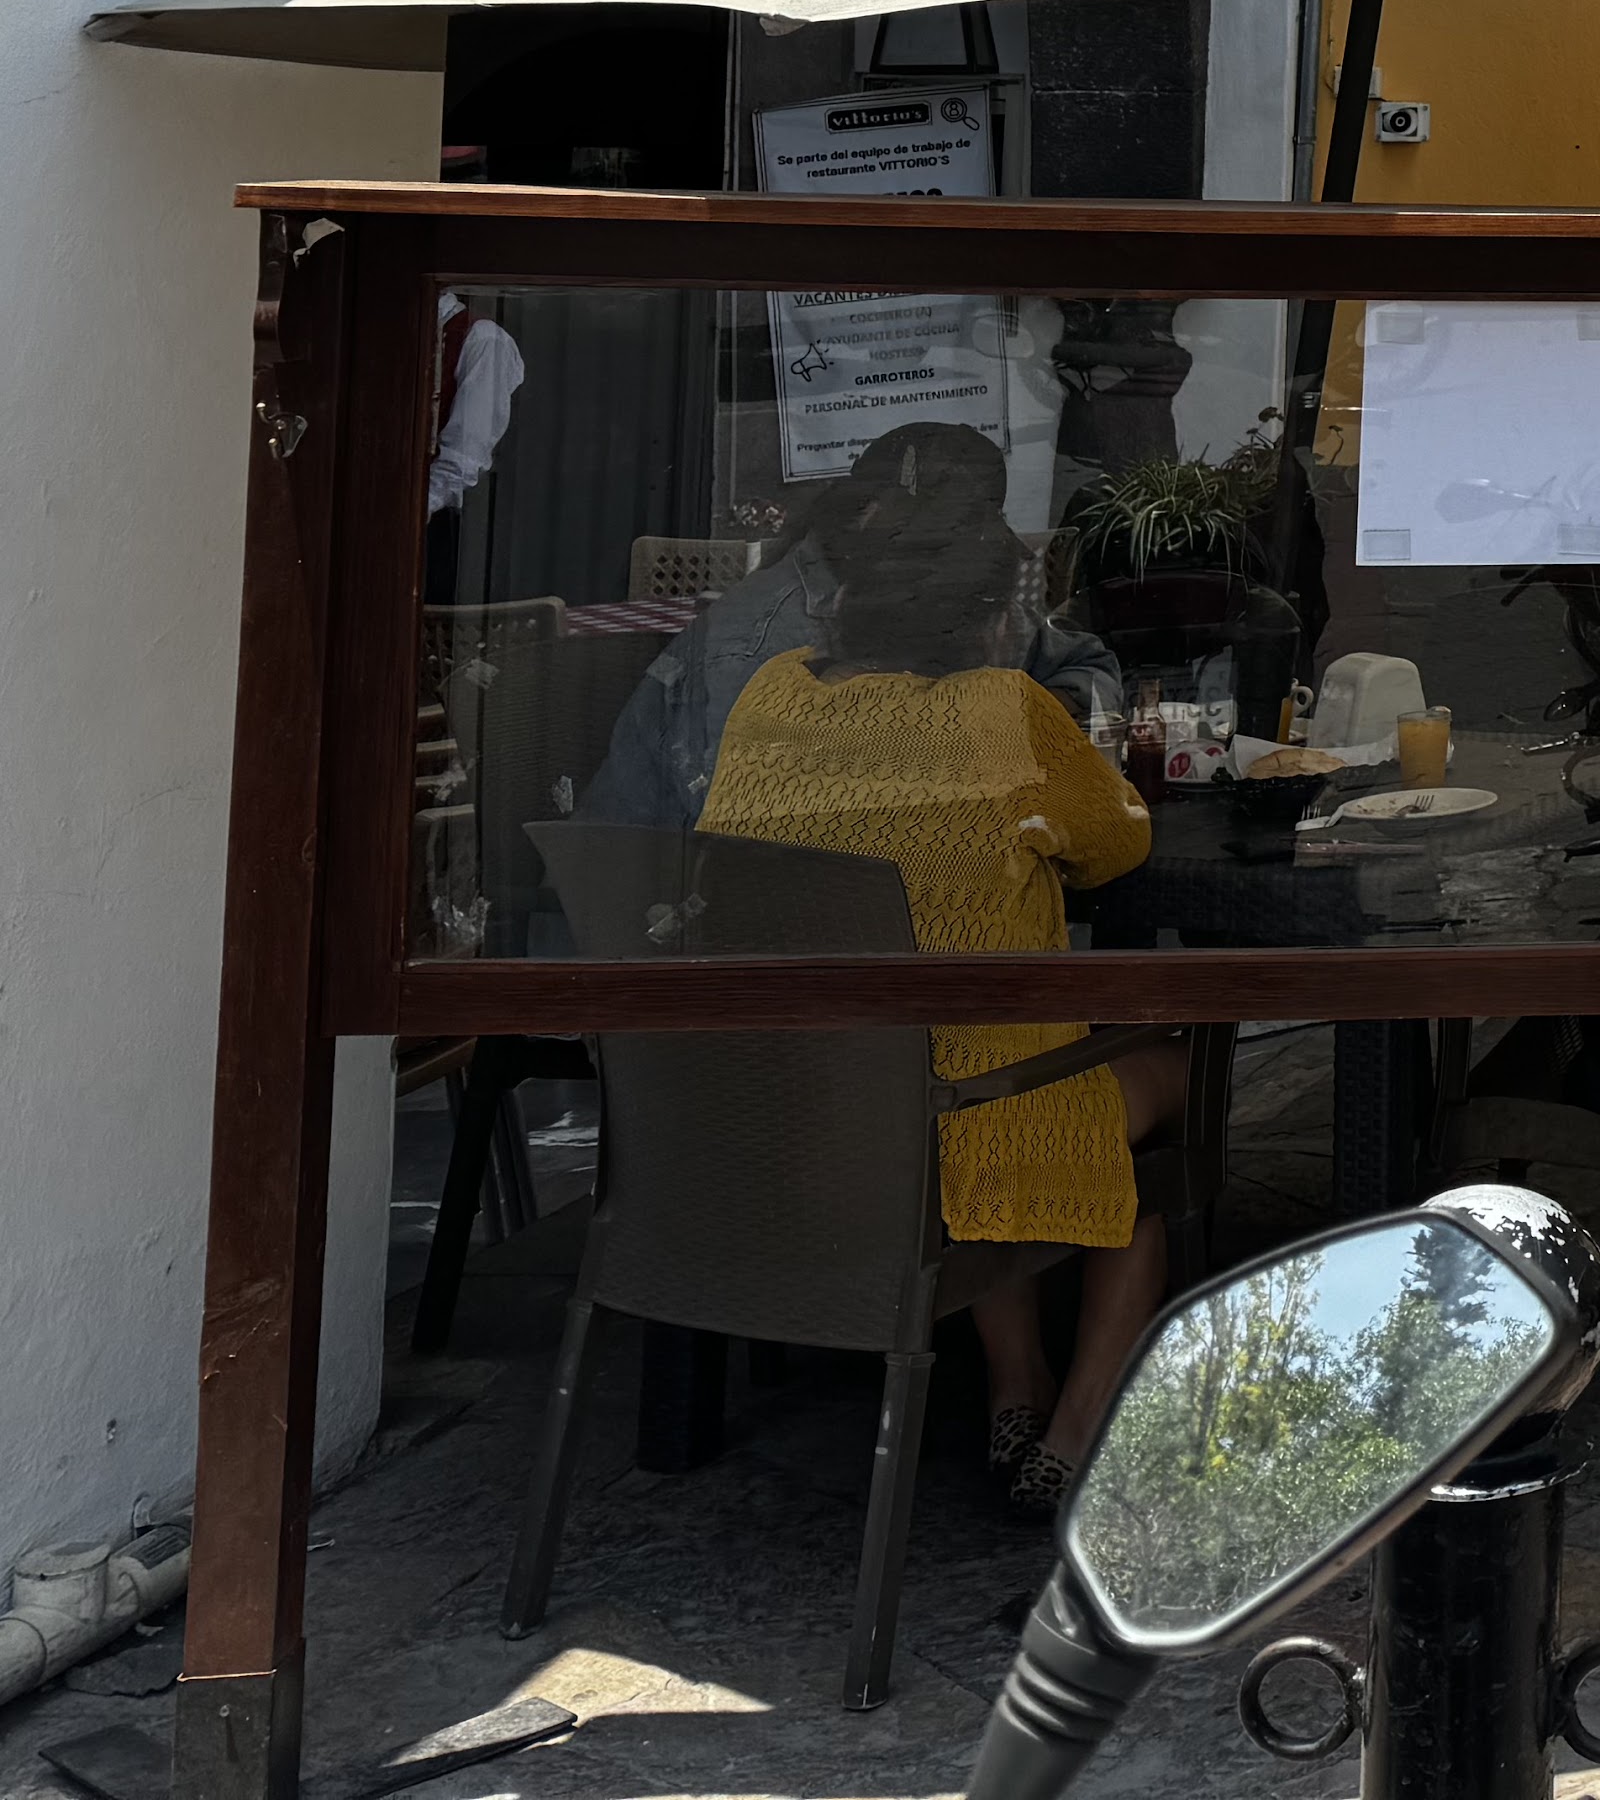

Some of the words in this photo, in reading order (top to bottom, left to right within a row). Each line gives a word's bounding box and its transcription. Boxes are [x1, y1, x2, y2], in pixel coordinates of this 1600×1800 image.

[777, 154, 794, 166] Se
[796, 153, 829, 166] parte
[830, 149, 849, 161] del
[851, 145, 891, 160] equipo
[893, 144, 909, 156] de
[911, 140, 953, 155] trabajo
[955, 138, 972, 149] de
[806, 163, 877, 179] restaurante
[878, 155, 951, 172] VITTORIO'S
[894, 329, 912, 340] DE
[854, 367, 936, 386] GARROTEROS
[804, 399, 868, 415] PERSONAL
[870, 396, 888, 408] DE
[889, 385, 989, 407] MANTENIMIENTO
